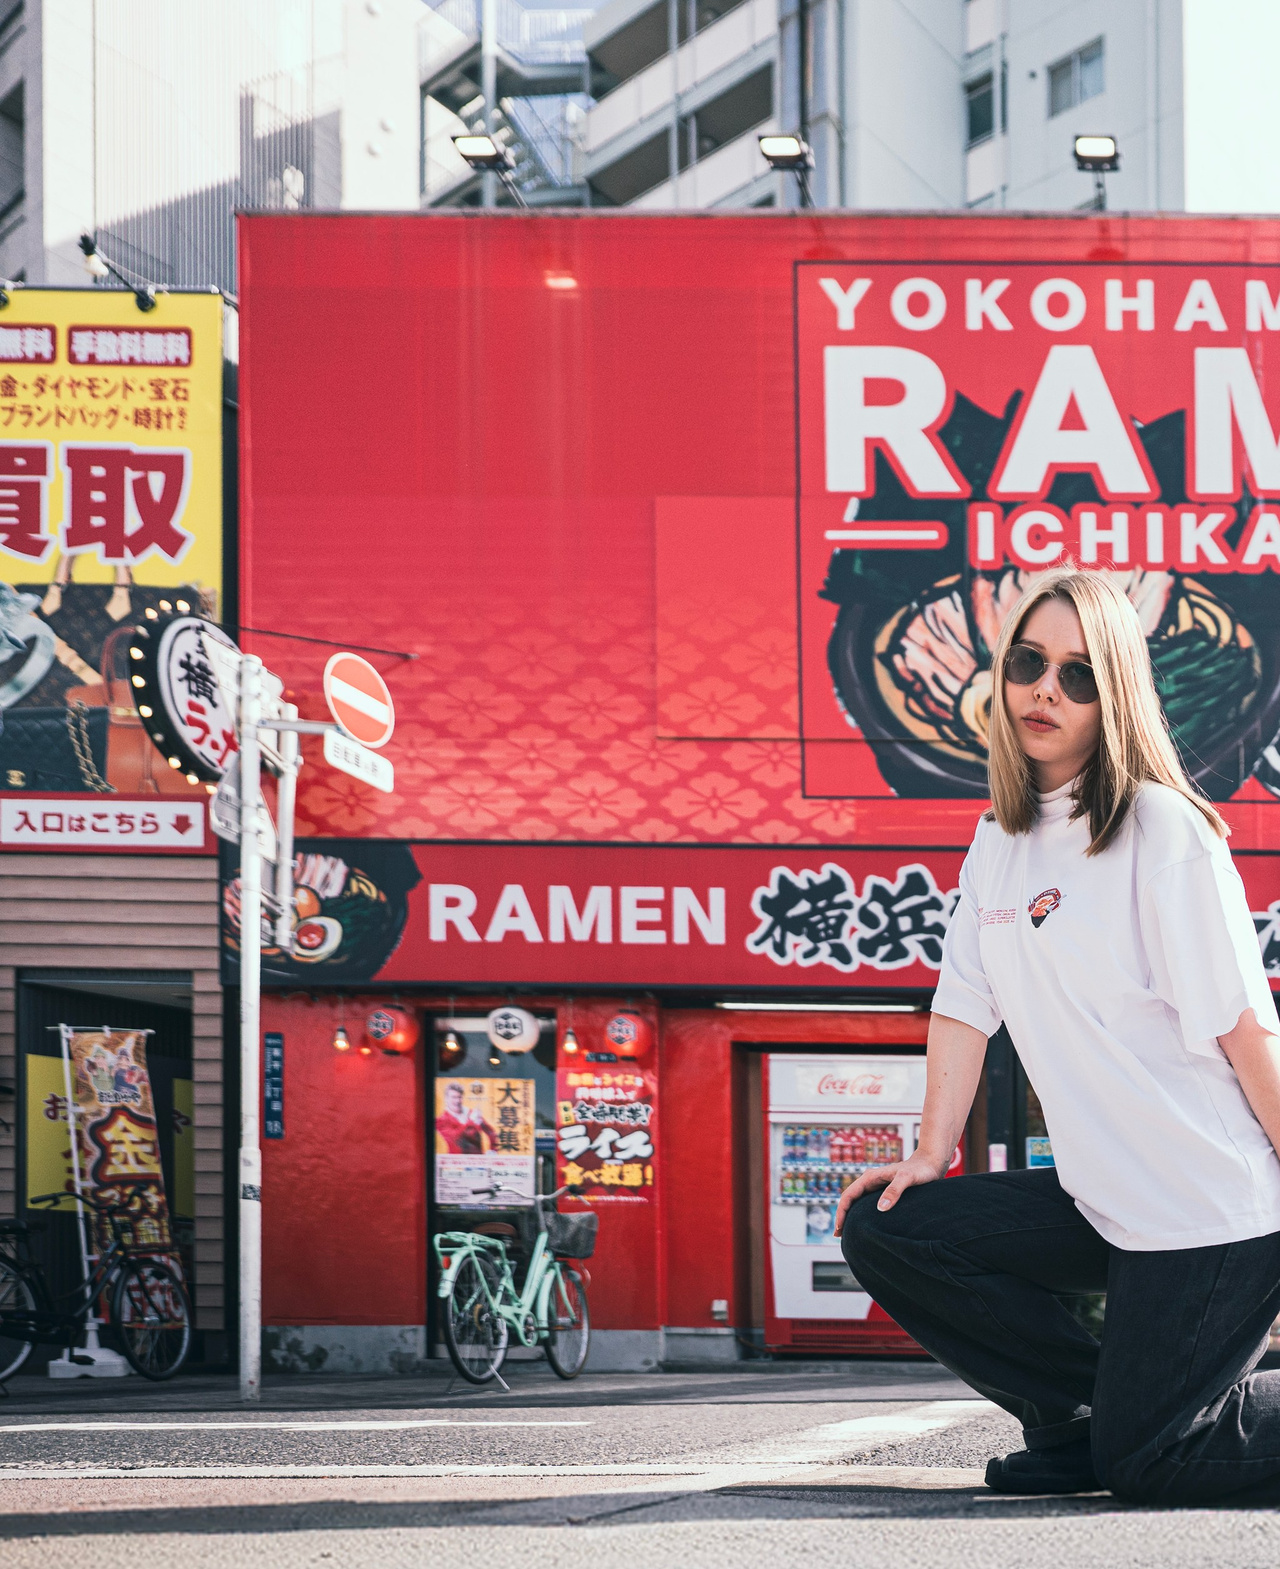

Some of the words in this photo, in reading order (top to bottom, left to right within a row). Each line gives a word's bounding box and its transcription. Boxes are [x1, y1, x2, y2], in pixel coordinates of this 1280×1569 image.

[15, 809, 160, 835] 入口はこちら
[429, 883, 726, 945] RAMEN
[746, 862, 958, 973] 横浜
[557, 1124, 655, 1161] ライス
